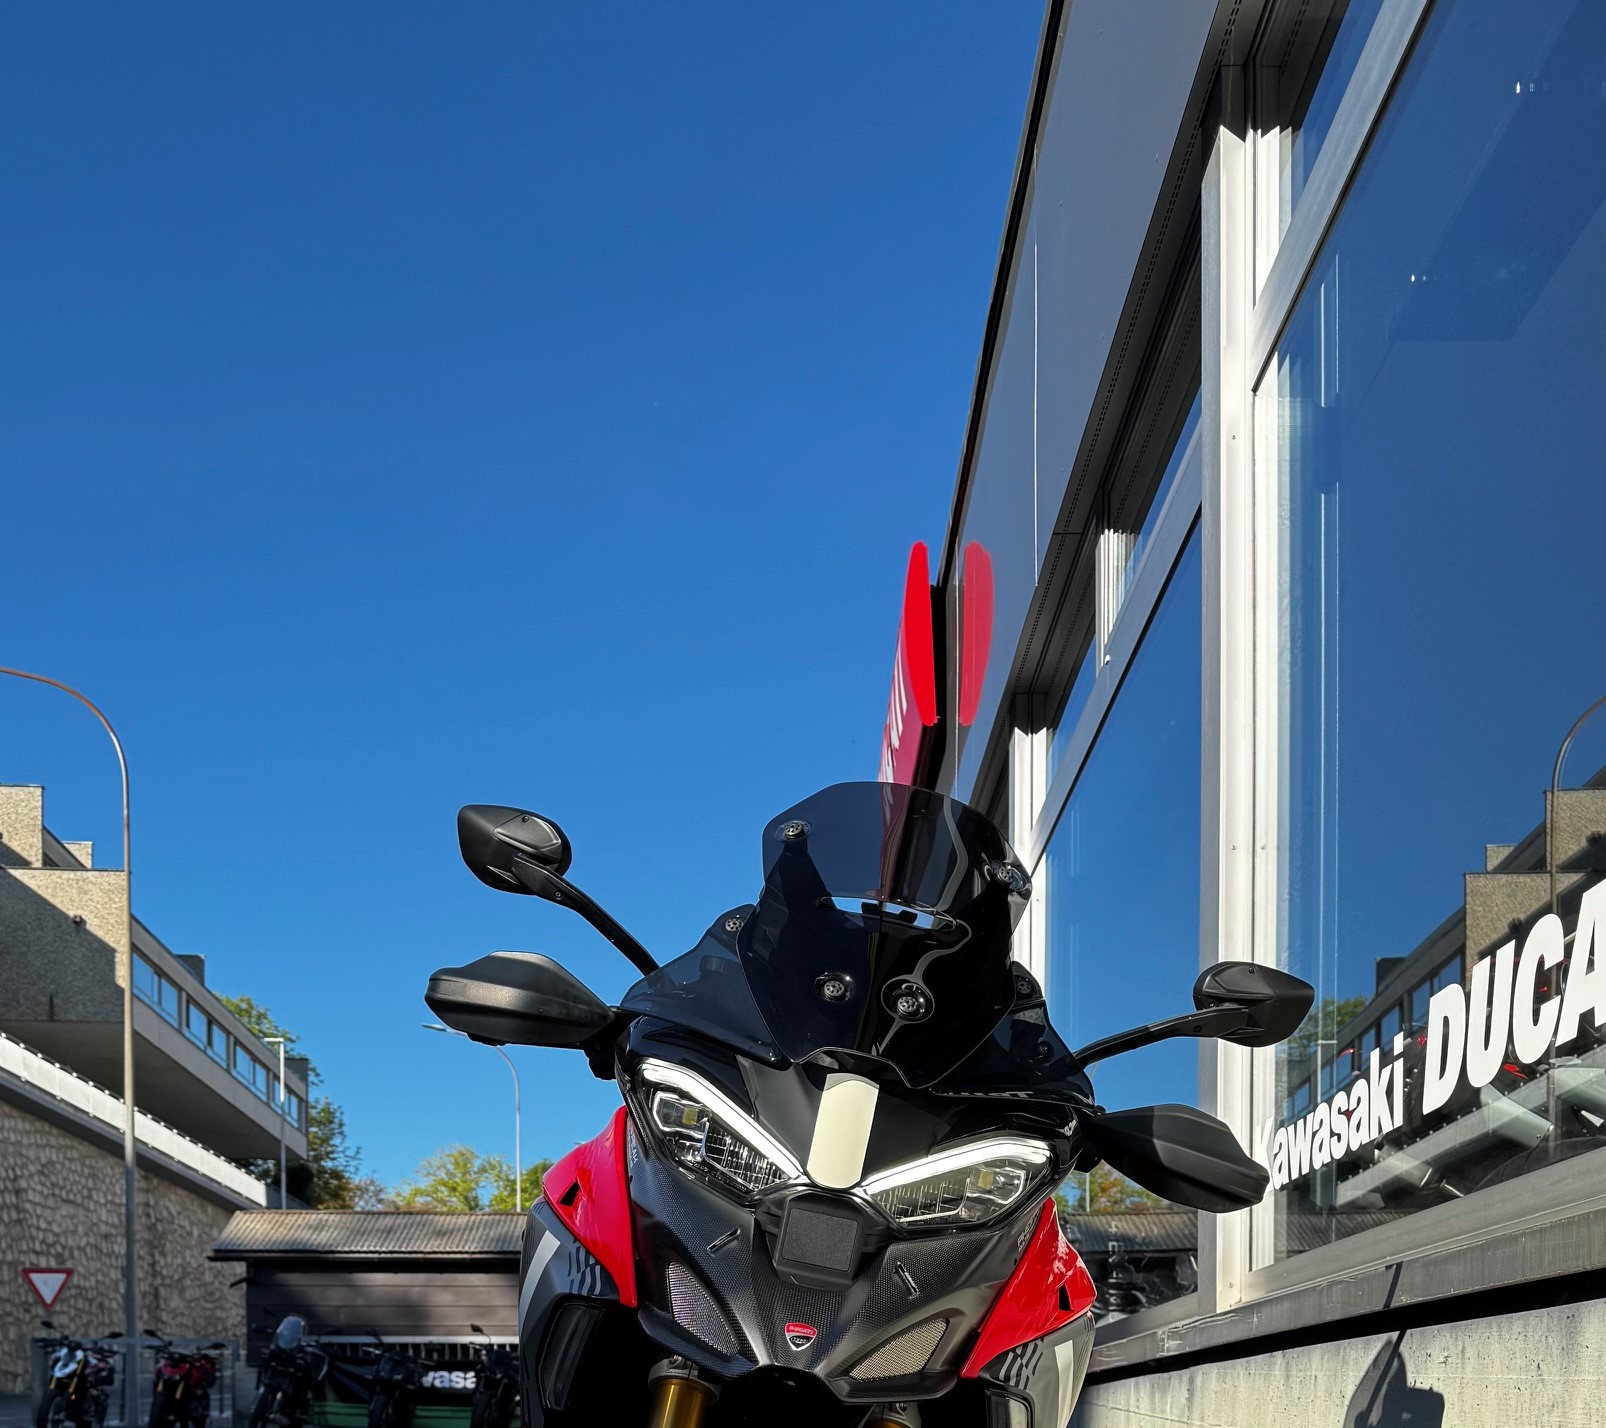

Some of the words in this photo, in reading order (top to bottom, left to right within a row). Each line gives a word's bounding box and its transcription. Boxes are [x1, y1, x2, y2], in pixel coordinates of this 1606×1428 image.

[1254, 1031, 1404, 1194] Kawasaki
[1423, 876, 1606, 1115] DUCA
[789, 1325, 814, 1334] DUCATI
